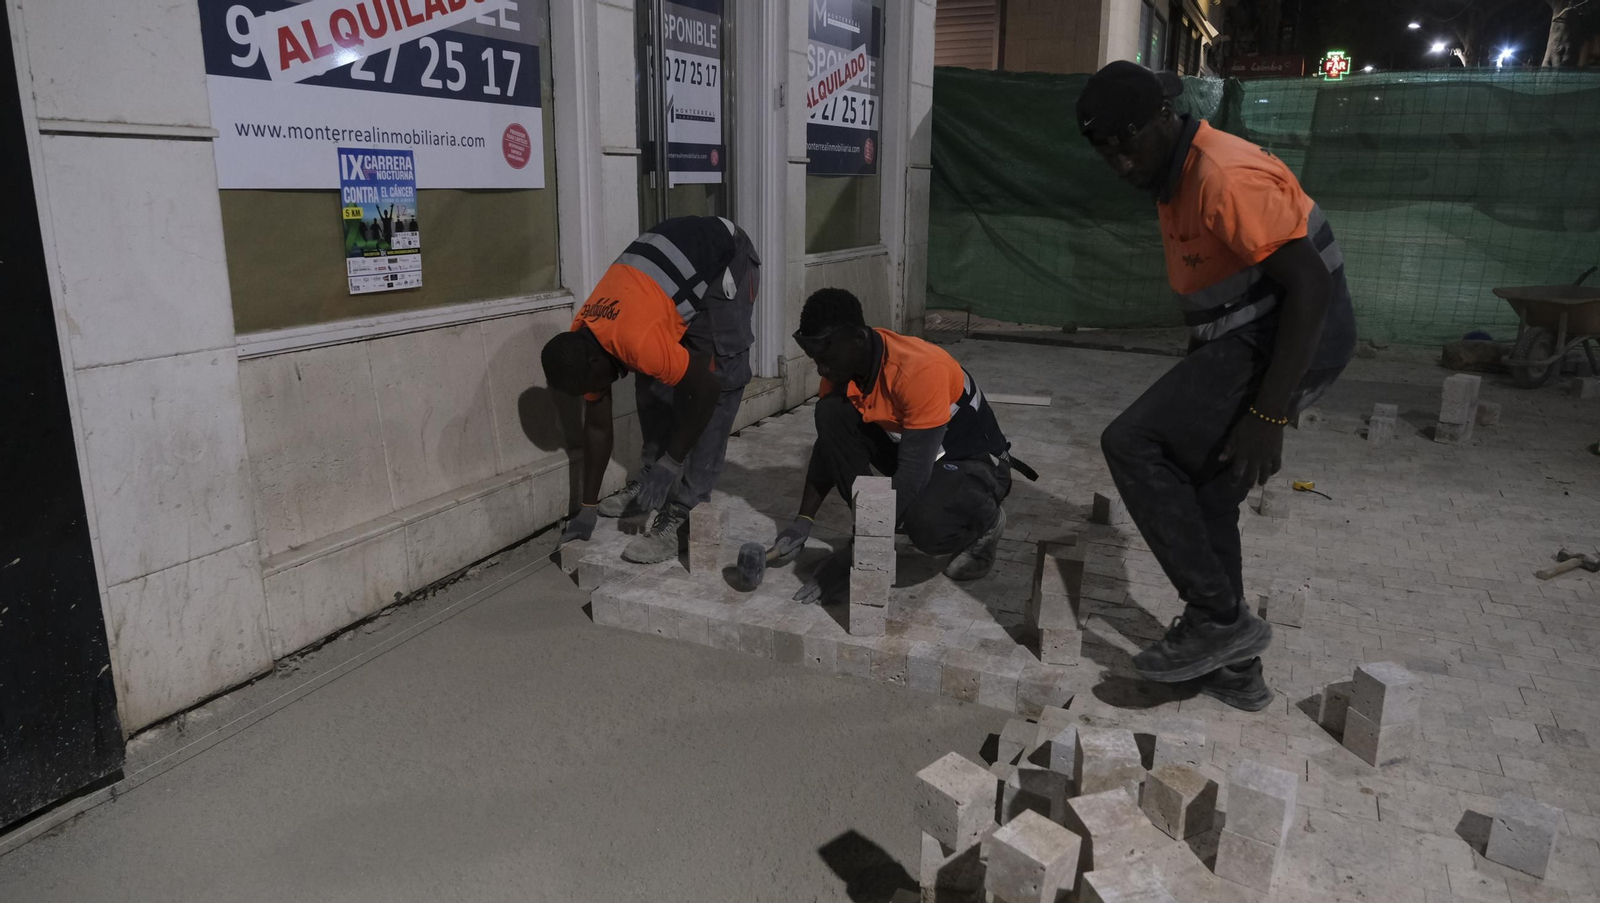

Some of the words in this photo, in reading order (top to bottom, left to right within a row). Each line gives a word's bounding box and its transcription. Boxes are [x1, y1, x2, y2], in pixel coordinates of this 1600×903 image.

[277, 0, 485, 71] ALQUILA
[419, 37, 467, 92] 25
[482, 47, 521, 97] 17
[674, 58, 687, 83] 27
[690, 61, 703, 86] 25
[706, 64, 717, 88] 17
[1326, 62, 1346, 71] FAR
[675, 108, 716, 117] MONTERREAL
[842, 95, 857, 124] 25
[861, 98, 875, 126] 17
[235, 121, 486, 149] www.monterrealinmobiliaria.com
[340, 154, 366, 180] IX
[364, 155, 413, 171] CARRERA
[376, 170, 414, 180] NOCTURNA
[343, 186, 380, 204] CONTRA
[380, 186, 389, 198] EL
[345, 209, 350, 218] 5
